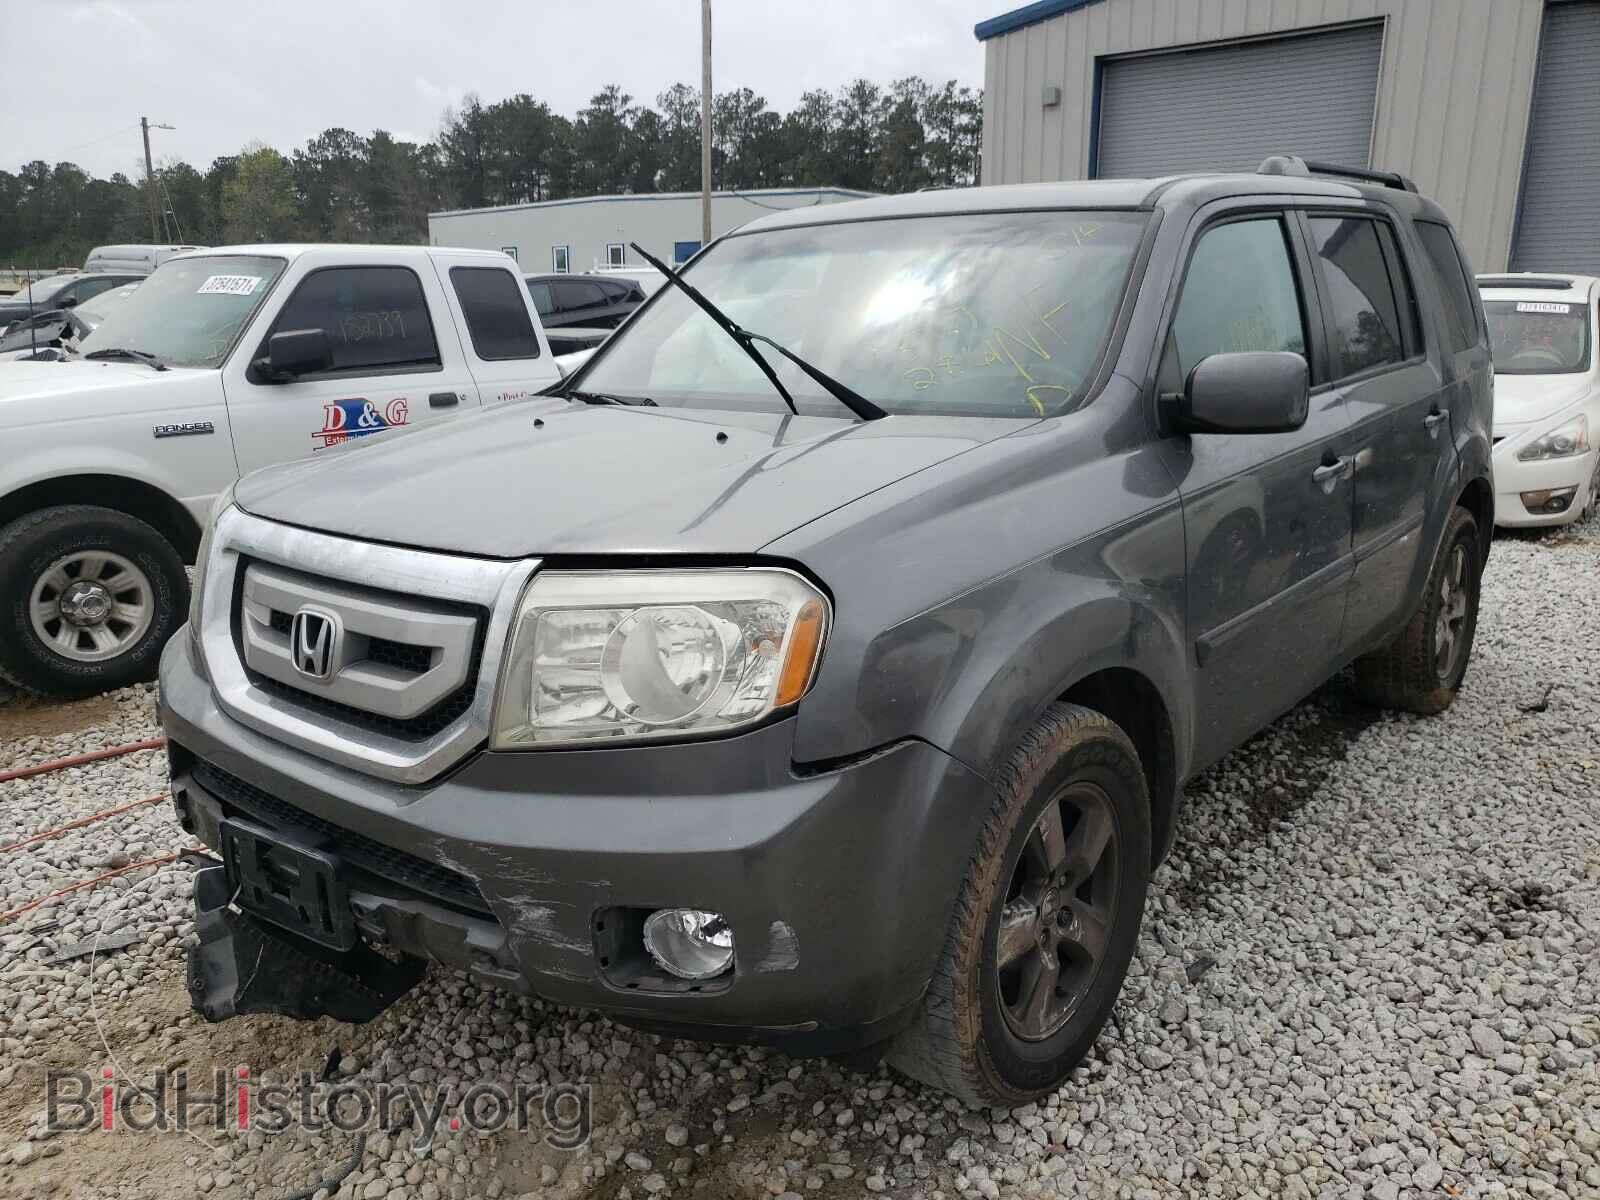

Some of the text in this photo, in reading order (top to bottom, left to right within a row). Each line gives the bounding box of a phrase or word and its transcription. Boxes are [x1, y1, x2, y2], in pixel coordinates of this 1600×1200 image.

[323, 398, 409, 431] D & G
[154, 421, 214, 433] RANGER
